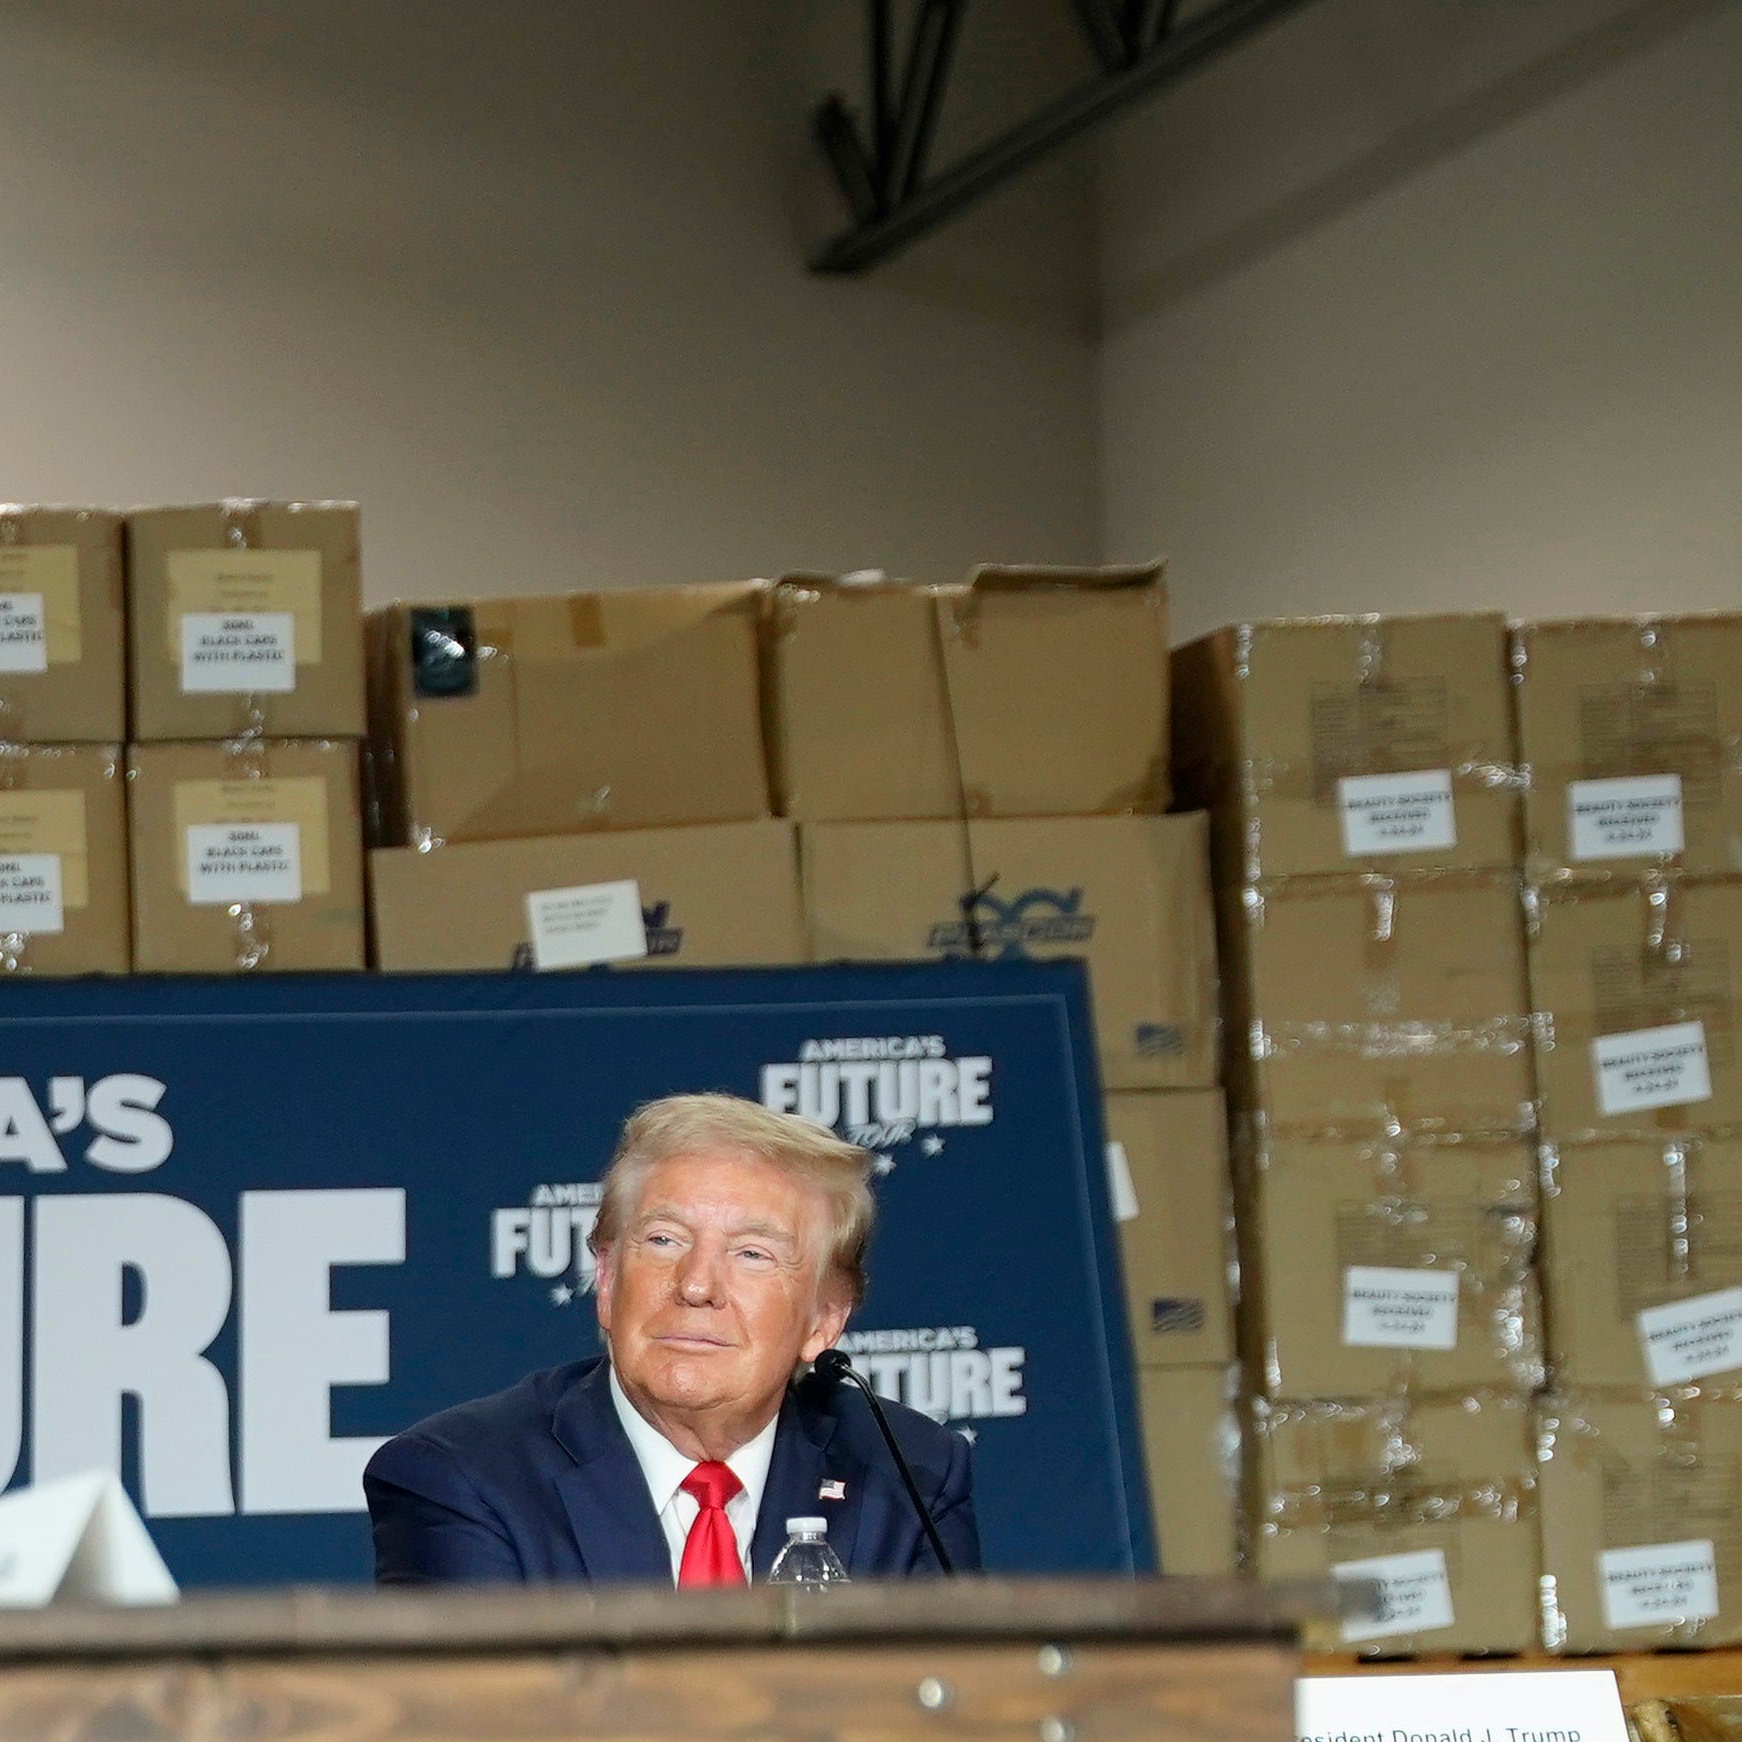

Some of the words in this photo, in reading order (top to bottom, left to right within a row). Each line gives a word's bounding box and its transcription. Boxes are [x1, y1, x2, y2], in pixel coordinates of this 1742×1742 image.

[799, 1035, 947, 1062] AMERICA'S
[759, 1056, 994, 1129] FUTURE
[841, 1346, 1028, 1420] TURE
